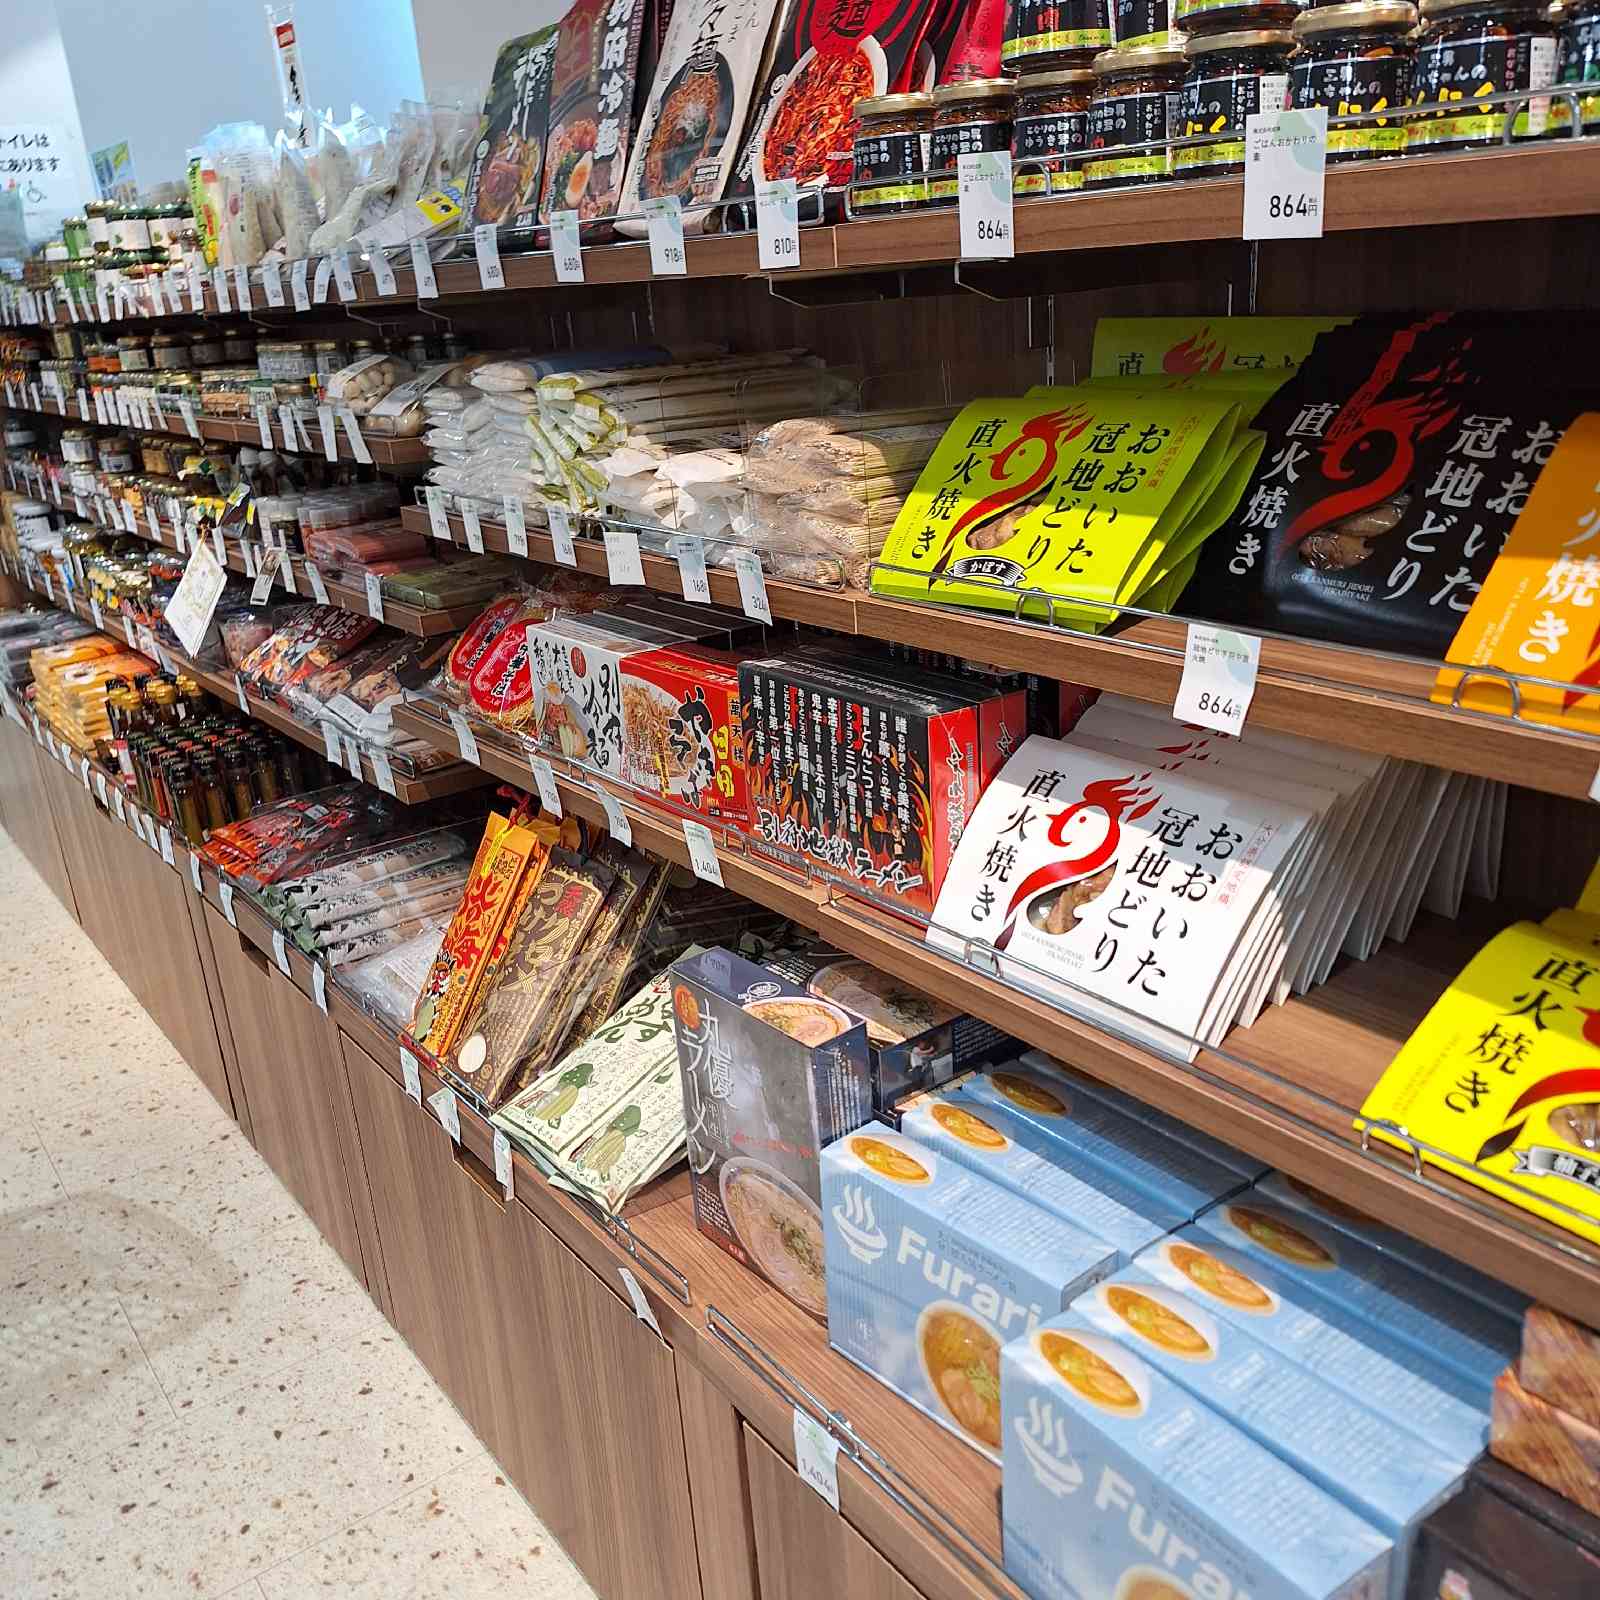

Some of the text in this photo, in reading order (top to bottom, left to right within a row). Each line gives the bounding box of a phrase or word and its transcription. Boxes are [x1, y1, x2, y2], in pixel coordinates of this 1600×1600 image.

[1253, 135, 1317, 149] ごはんおかわりの
[911, 416, 1008, 560] 直火焼き
[1026, 421, 1132, 570] 冠地どり
[1055, 422, 1171, 575] おおいた
[1228, 402, 1341, 576] 直火焼き
[1381, 414, 1512, 600] 冠地どり
[969, 559, 1007, 577] かぼす
[754, 806, 922, 894] 別府地獄ラーメン
[970, 766, 1068, 922] 直火焼き
[1094, 806, 1200, 973] 冠地どり
[1127, 822, 1243, 997] おおいた
[682, 1028, 716, 1175] ラーメン
[1444, 951, 1600, 1114] 直火焼き
[896, 1226, 1043, 1332] Furari
[1095, 1466, 1258, 1600] Fura
